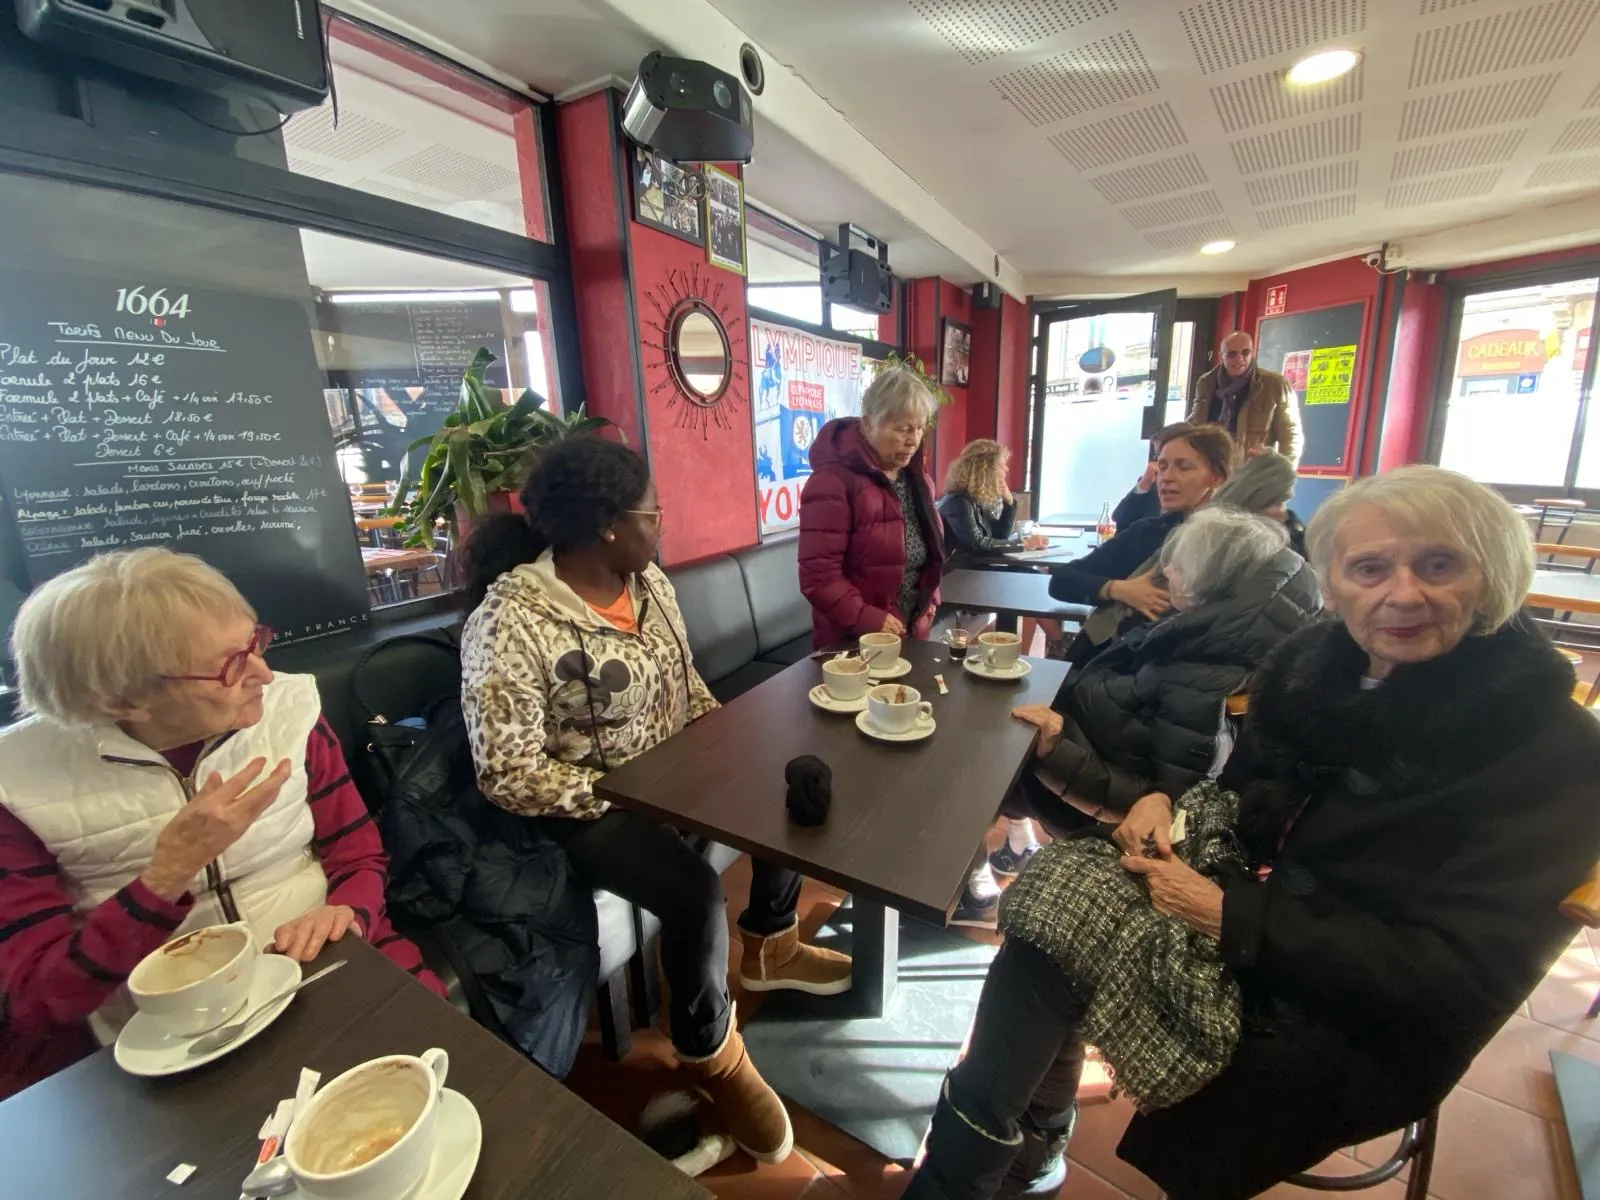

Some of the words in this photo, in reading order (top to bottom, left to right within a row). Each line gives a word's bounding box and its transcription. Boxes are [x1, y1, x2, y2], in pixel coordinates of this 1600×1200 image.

[116, 285, 192, 319] 1664
[0, 342, 38, 366] Plat
[46, 351, 72, 365] du
[751, 324, 860, 381] LYMPIQUE
[1468, 340, 1539, 359] CADEAUX
[0, 369, 53, 386] ormule
[82, 371, 121, 394] plats
[86, 389, 120, 411] plats
[135, 388, 166, 410] Café
[51, 406, 88, 425] Plat
[52, 425, 87, 442] Plat
[165, 429, 190, 446] Café
[273, 630, 293, 641] EN
[305, 614, 368, 633] FRANCE
